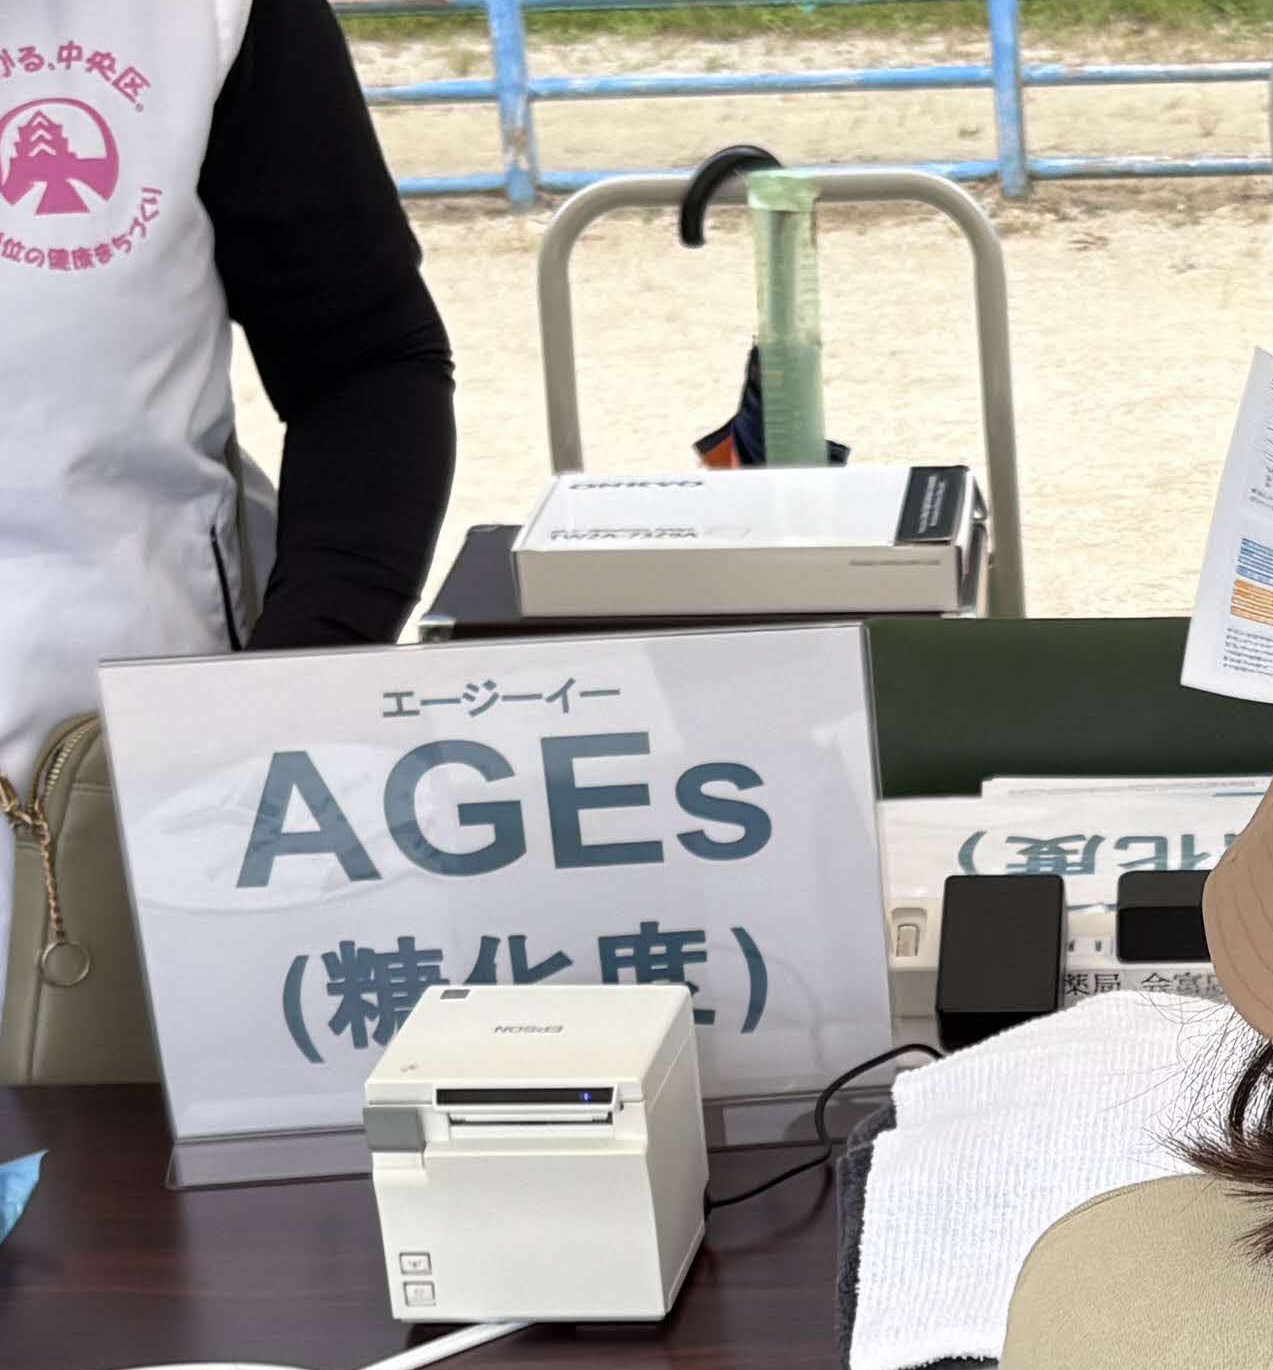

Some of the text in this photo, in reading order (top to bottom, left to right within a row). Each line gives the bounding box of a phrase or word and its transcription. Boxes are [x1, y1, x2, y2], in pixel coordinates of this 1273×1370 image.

[382, 677, 621, 719] エージーイー
[236, 730, 774, 889] AGEs
